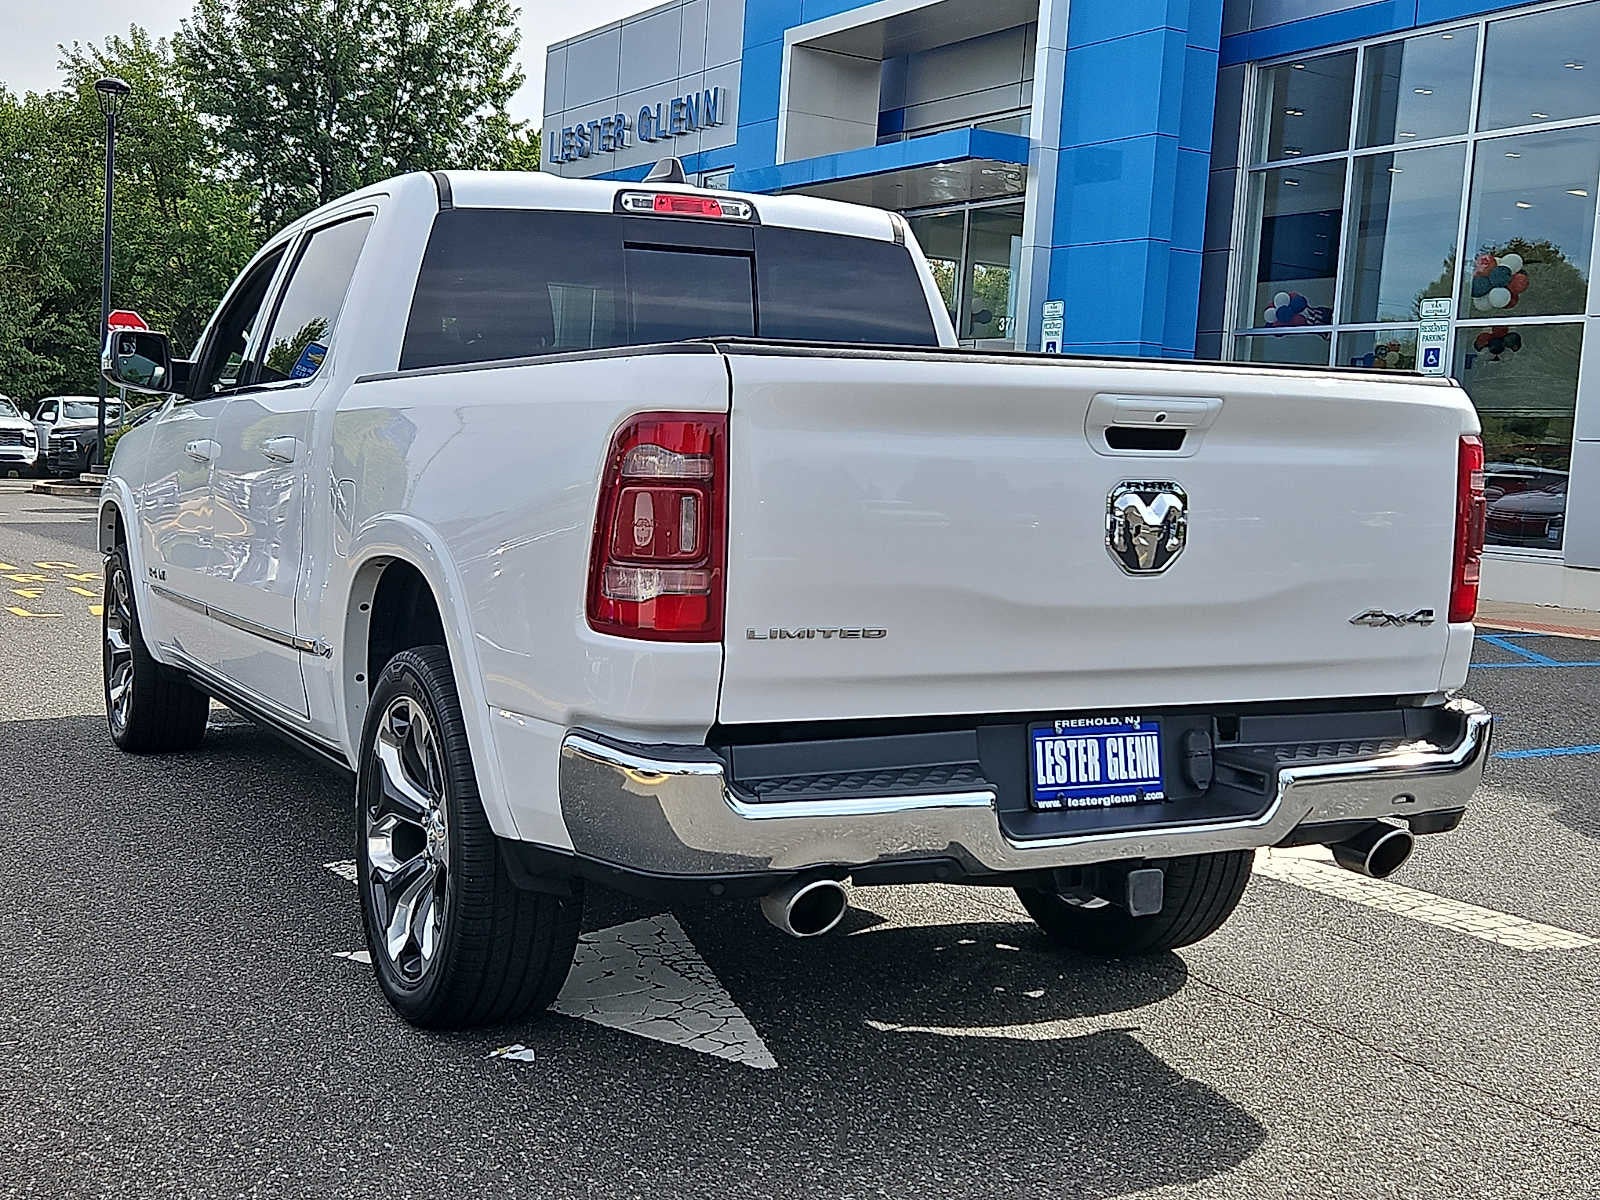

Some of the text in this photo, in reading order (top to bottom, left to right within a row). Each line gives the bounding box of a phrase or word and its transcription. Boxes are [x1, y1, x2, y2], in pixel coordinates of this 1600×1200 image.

[549, 86, 726, 164] LESTER GLENN
[1420, 324, 1448, 332] RESERVED
[1422, 334, 1446, 342] PARKING
[746, 627, 888, 640] LIMITED
[1054, 716, 1141, 728] FREEHOLD, NJ
[1035, 735, 1160, 785] LESTER GLENN
[1037, 791, 1164, 809] www. lesterglenn .com
